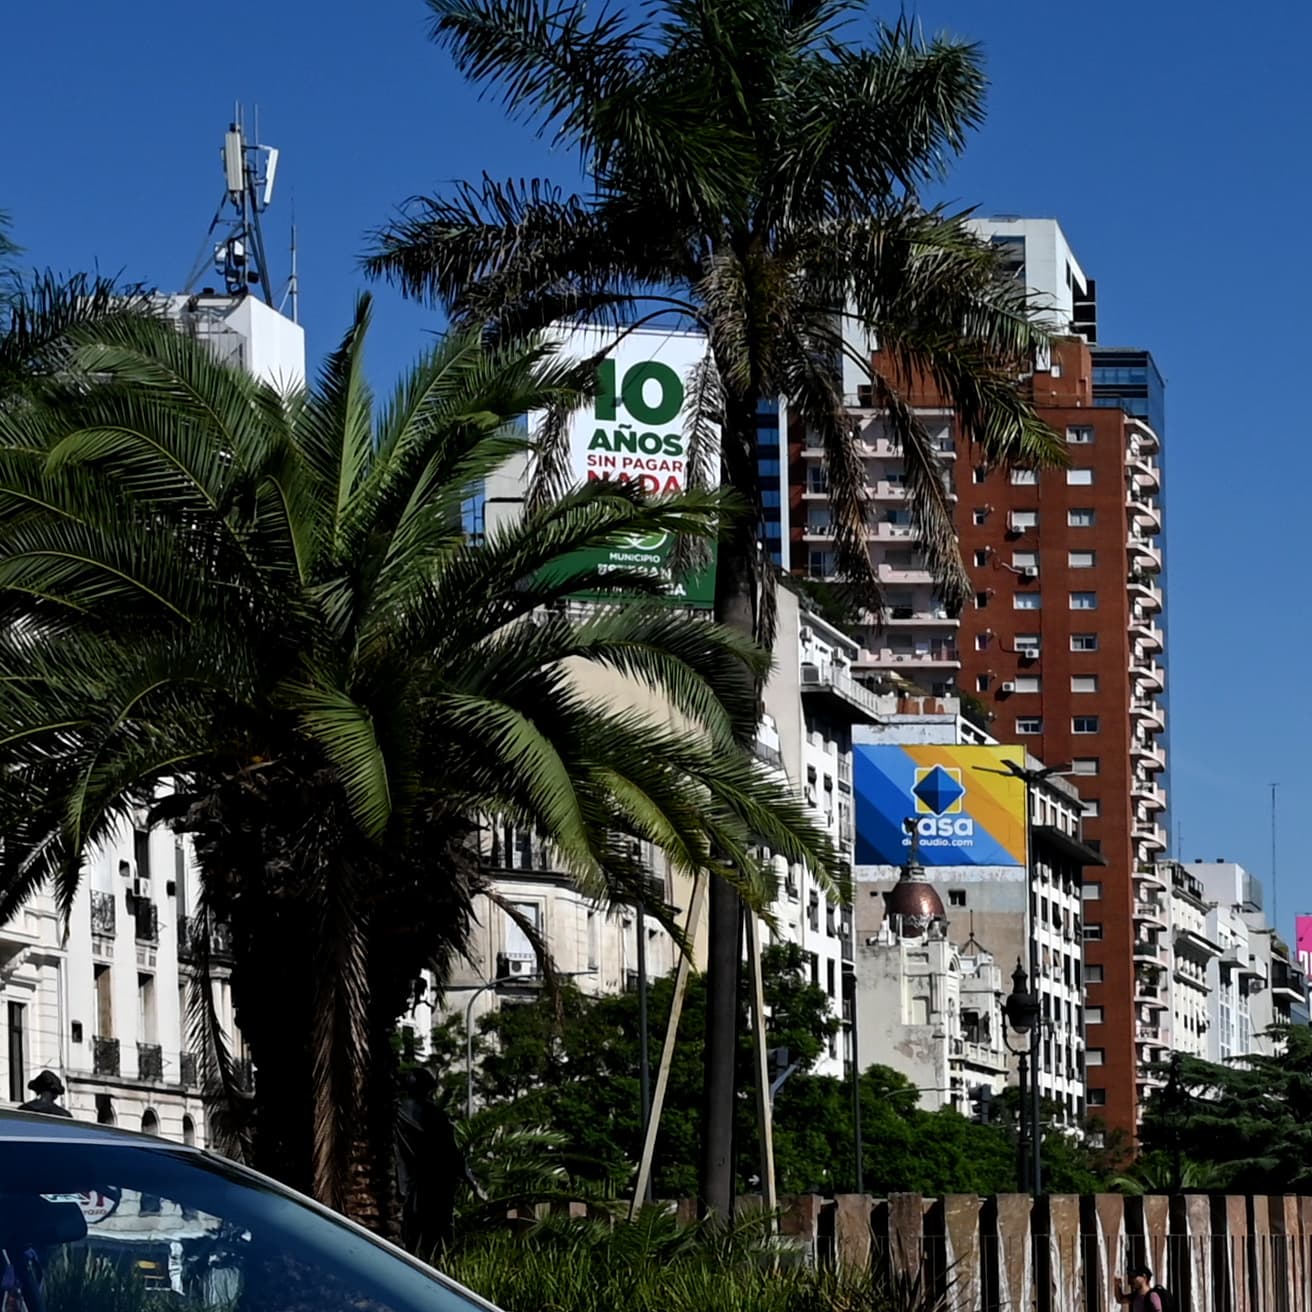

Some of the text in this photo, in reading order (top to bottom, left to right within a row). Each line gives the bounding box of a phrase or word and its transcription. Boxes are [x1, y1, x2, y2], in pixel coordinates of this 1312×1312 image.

[594, 358, 684, 425] 10
[587, 424, 684, 456] AÑOS
[587, 454, 683, 472] SIN PAGAR
[609, 552, 661, 563] MUNICIPIO
